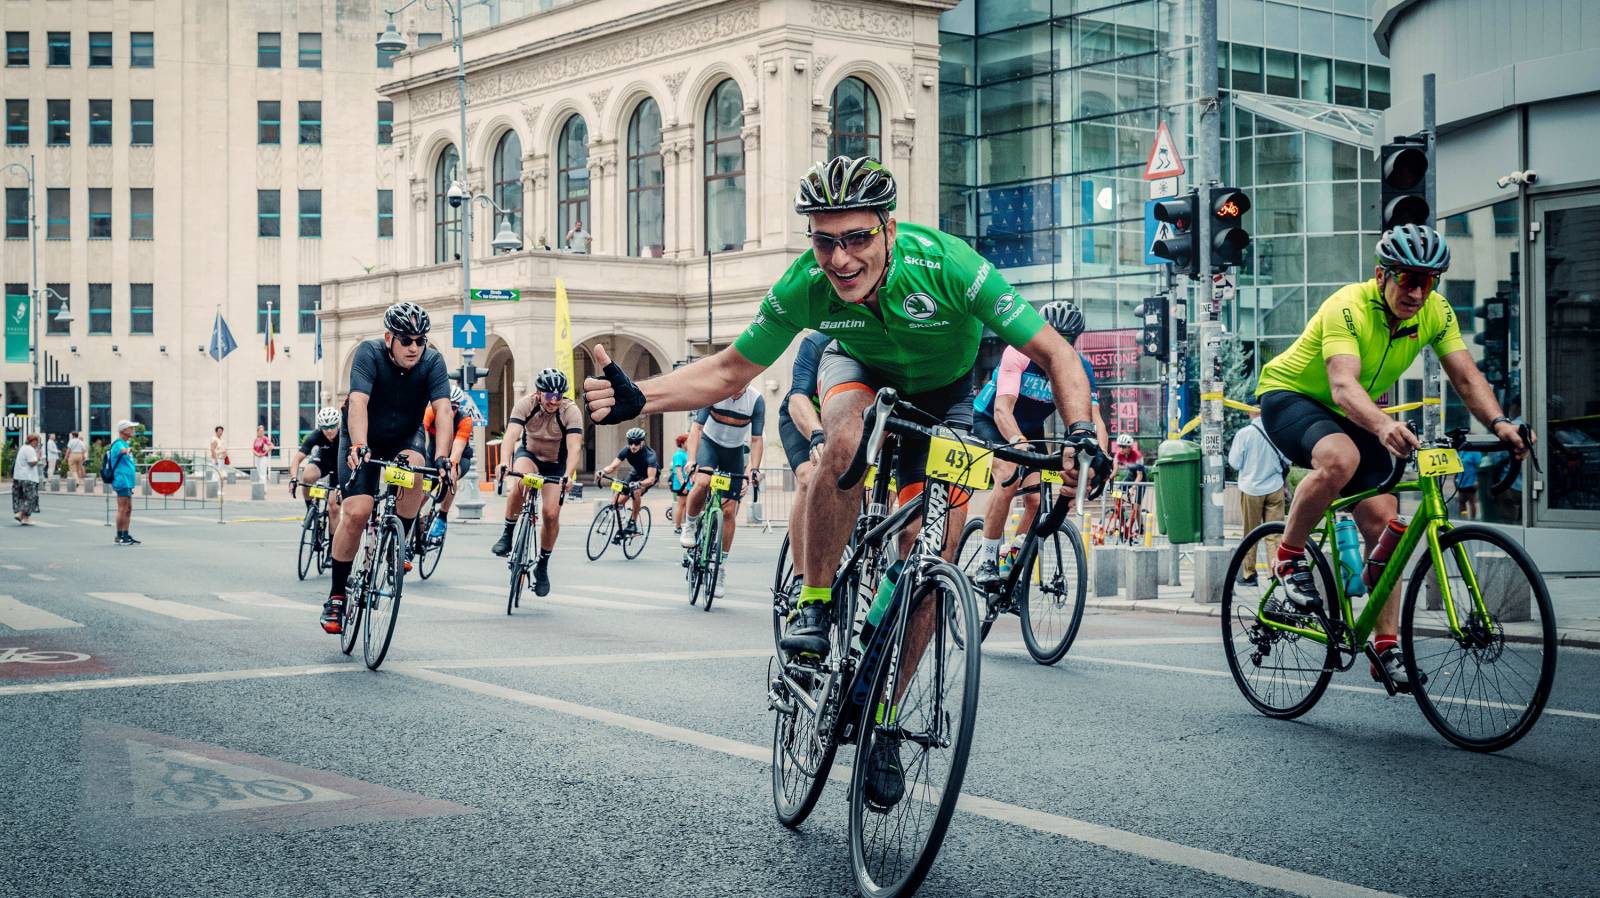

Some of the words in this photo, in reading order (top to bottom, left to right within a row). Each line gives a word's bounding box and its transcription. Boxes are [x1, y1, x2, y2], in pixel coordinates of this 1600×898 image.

[819, 320, 866, 329] Santini
[1121, 404, 1135, 416] 41
[1120, 419, 1138, 433] LEI
[1430, 453, 1448, 466] 214
[393, 471, 406, 480] 236
